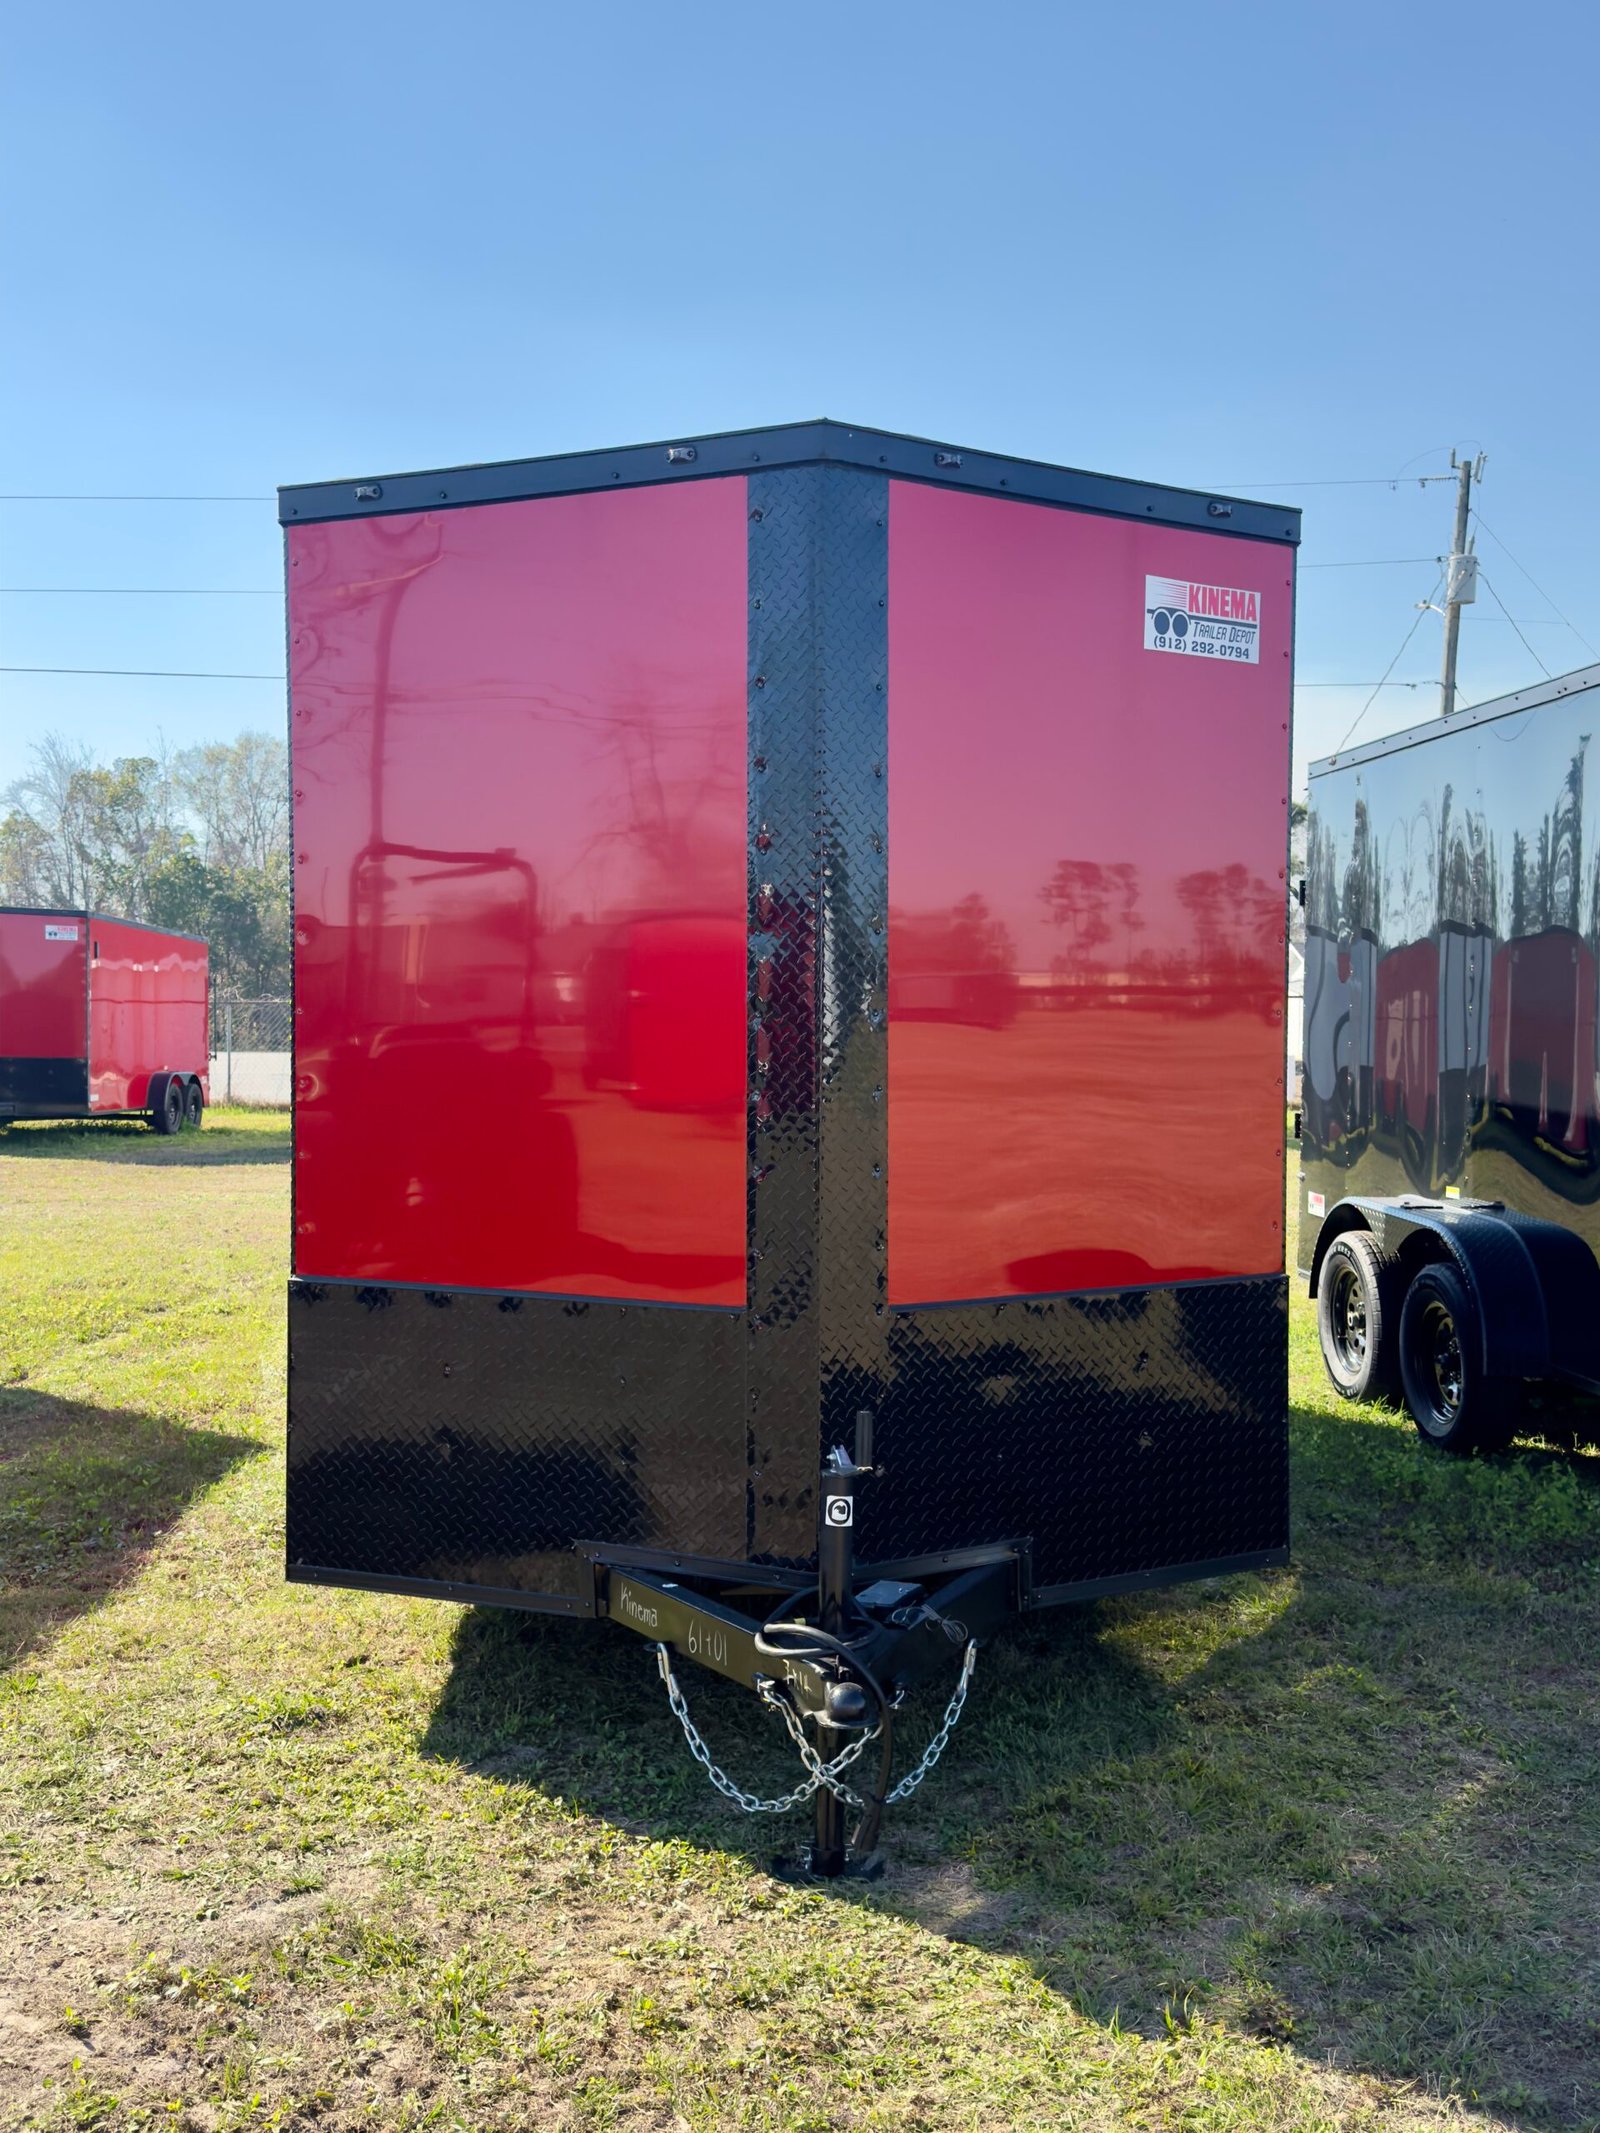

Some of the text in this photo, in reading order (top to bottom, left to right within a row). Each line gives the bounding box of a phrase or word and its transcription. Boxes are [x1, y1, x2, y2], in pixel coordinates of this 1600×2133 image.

[1188, 584, 1257, 622] KINEMA
[1154, 636, 1250, 659] (912) 292-0794
[1194, 622, 1256, 645] TRAILER DEPOT
[620, 1581, 658, 1628] Kinema
